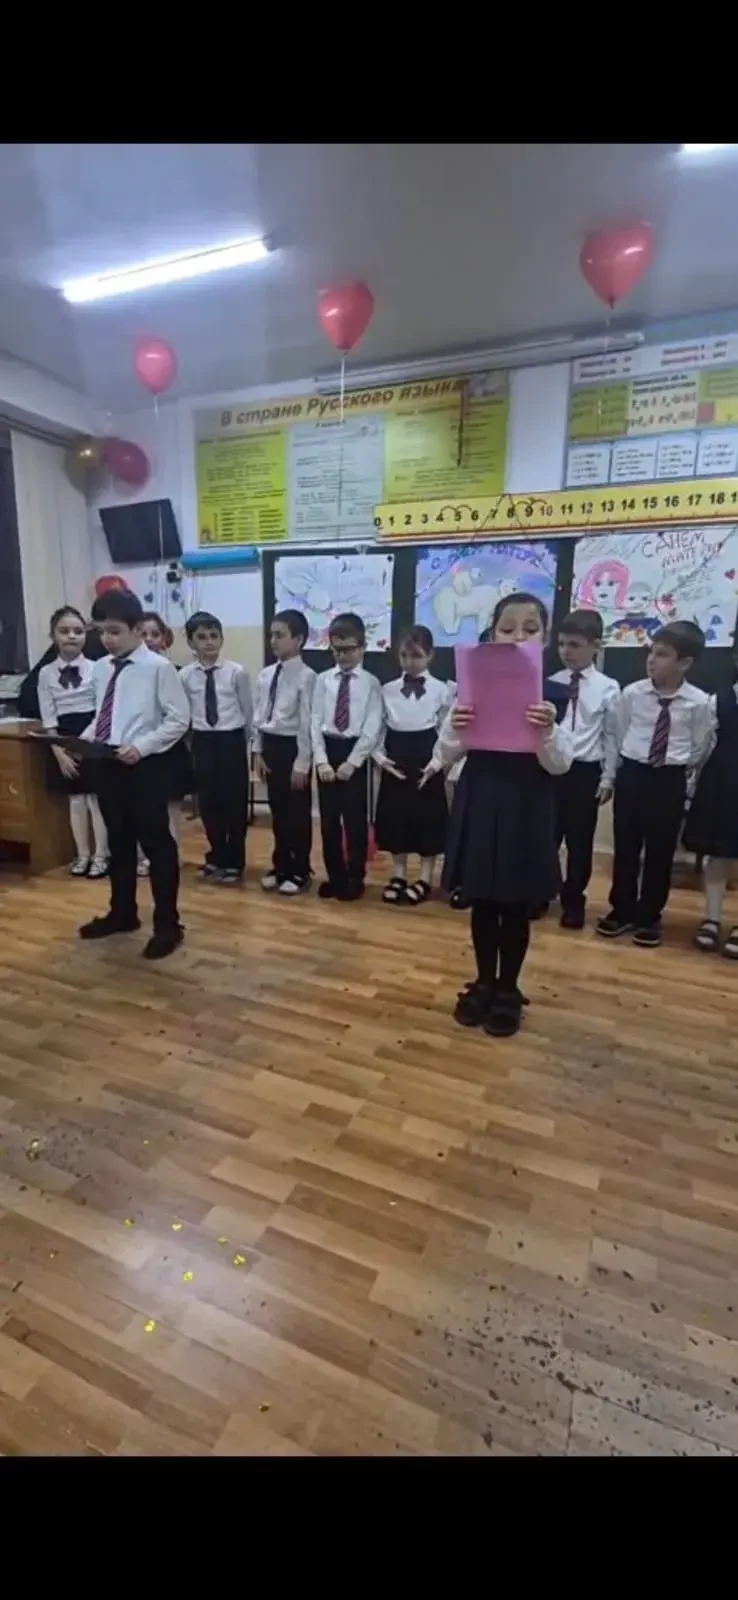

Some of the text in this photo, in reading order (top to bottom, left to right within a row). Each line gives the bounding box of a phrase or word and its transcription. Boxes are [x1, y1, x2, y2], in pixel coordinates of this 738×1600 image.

[221, 411, 232, 426] В
[236, 403, 302, 425] стране
[307, 388, 395, 417] Русского
[399, 379, 464, 402] языка
[374, 517, 382, 527] 0
[389, 516, 395, 526] 1
[404, 514, 412, 525] 2
[421, 513, 429, 524] 3
[436, 512, 444, 522] 4
[454, 510, 462, 521] 5
[471, 510, 479, 521] 6
[490, 508, 498, 519] 7
[507, 506, 515, 518] 8
[525, 505, 533, 517] 9
[540, 505, 553, 517] 10
[561, 503, 573, 515] 11
[581, 502, 593, 514] 12
[601, 500, 614, 513] 13
[621, 498, 635, 511] 14
[642, 497, 658, 509] 15
[664, 495, 679, 508] 16
[687, 493, 702, 506] 17
[709, 491, 725, 505] 18
